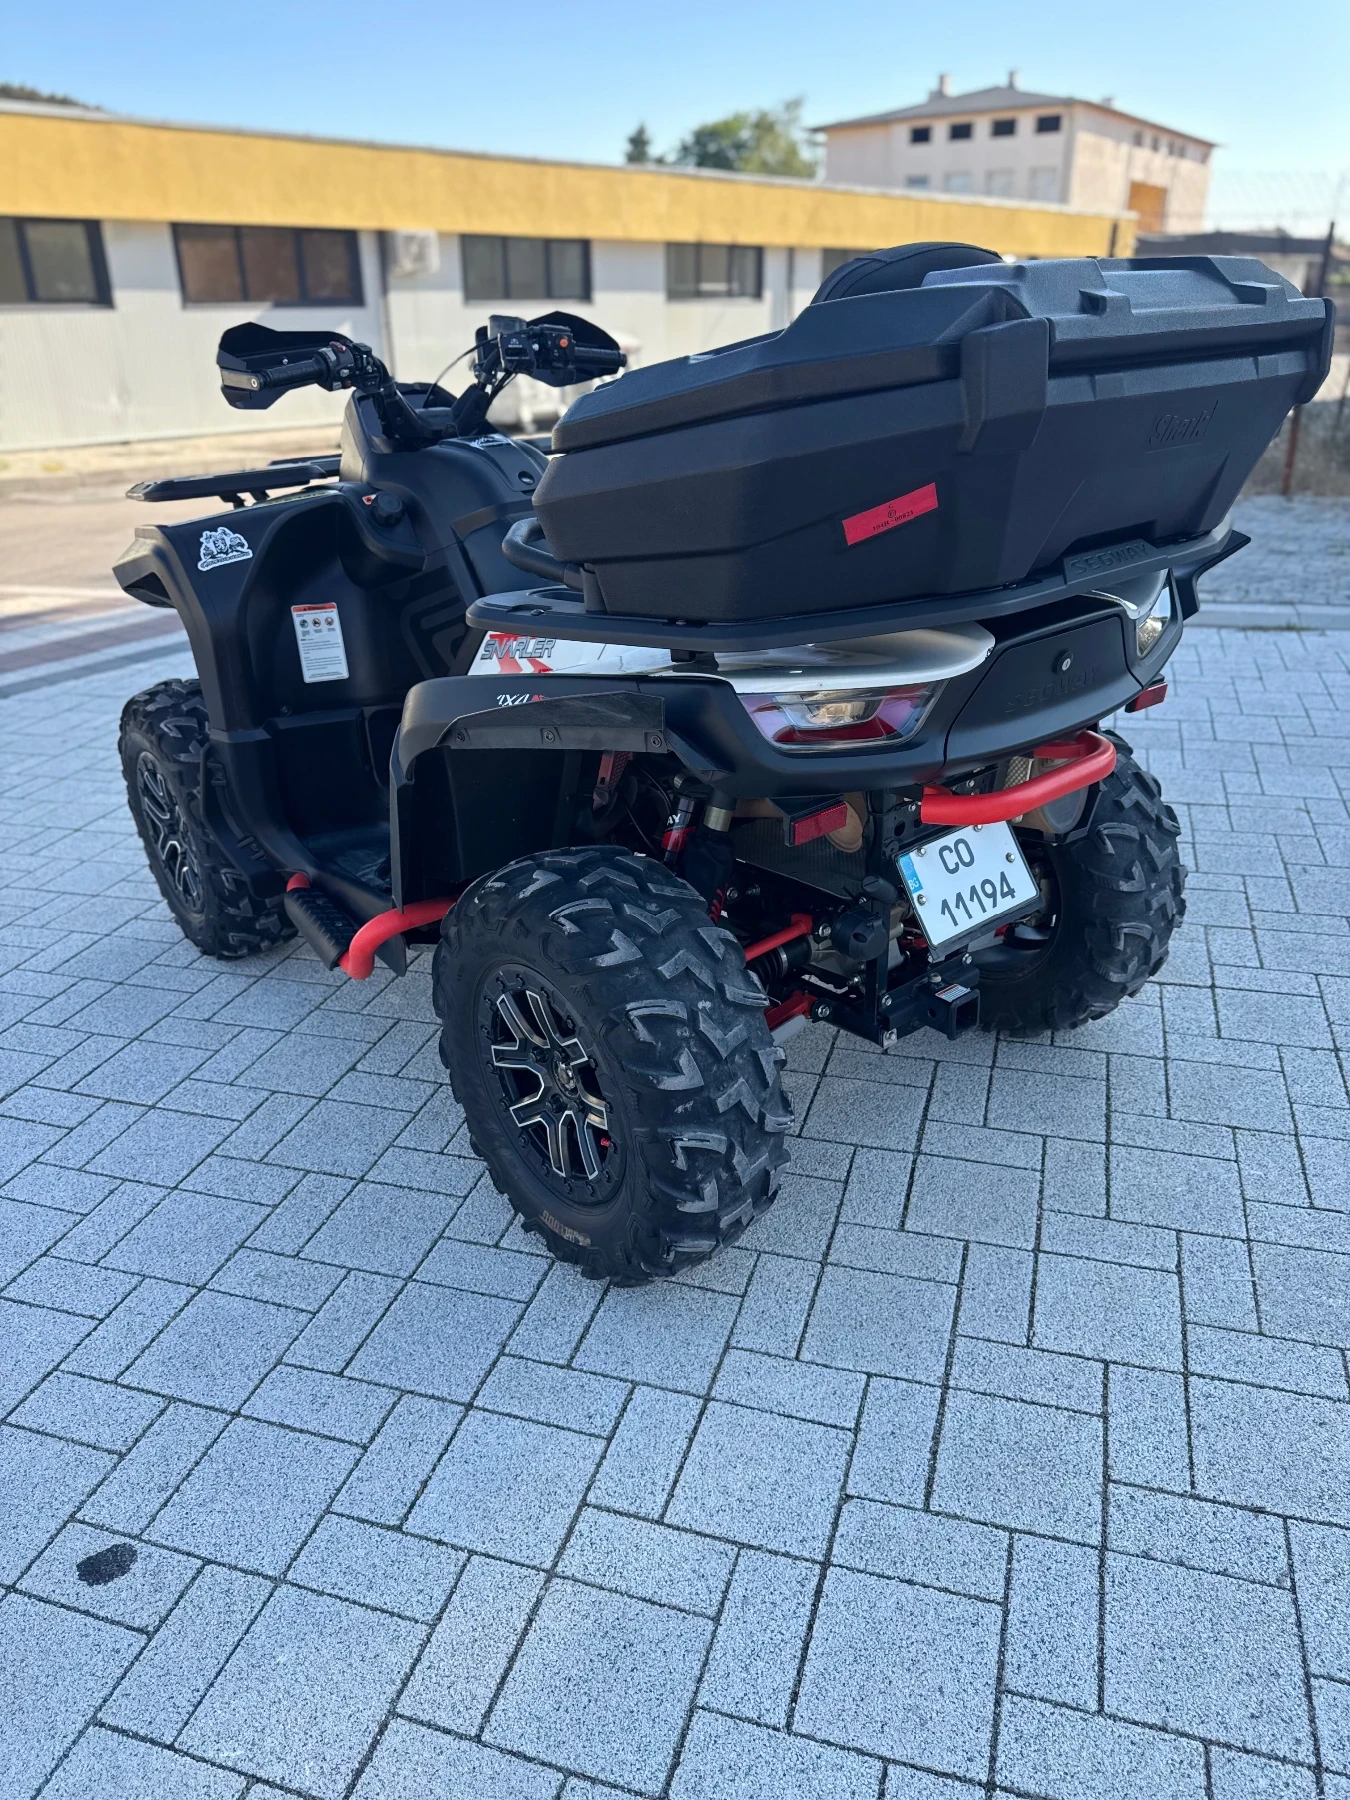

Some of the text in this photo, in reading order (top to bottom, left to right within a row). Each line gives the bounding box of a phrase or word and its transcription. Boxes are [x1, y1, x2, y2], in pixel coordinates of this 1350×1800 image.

[1069, 541, 1148, 575] SEGWAY
[480, 635, 557, 660] SNARLER
[1003, 664, 1101, 713] SEGWAY
[938, 837, 975, 875] CO
[940, 870, 1016, 928] 11194
